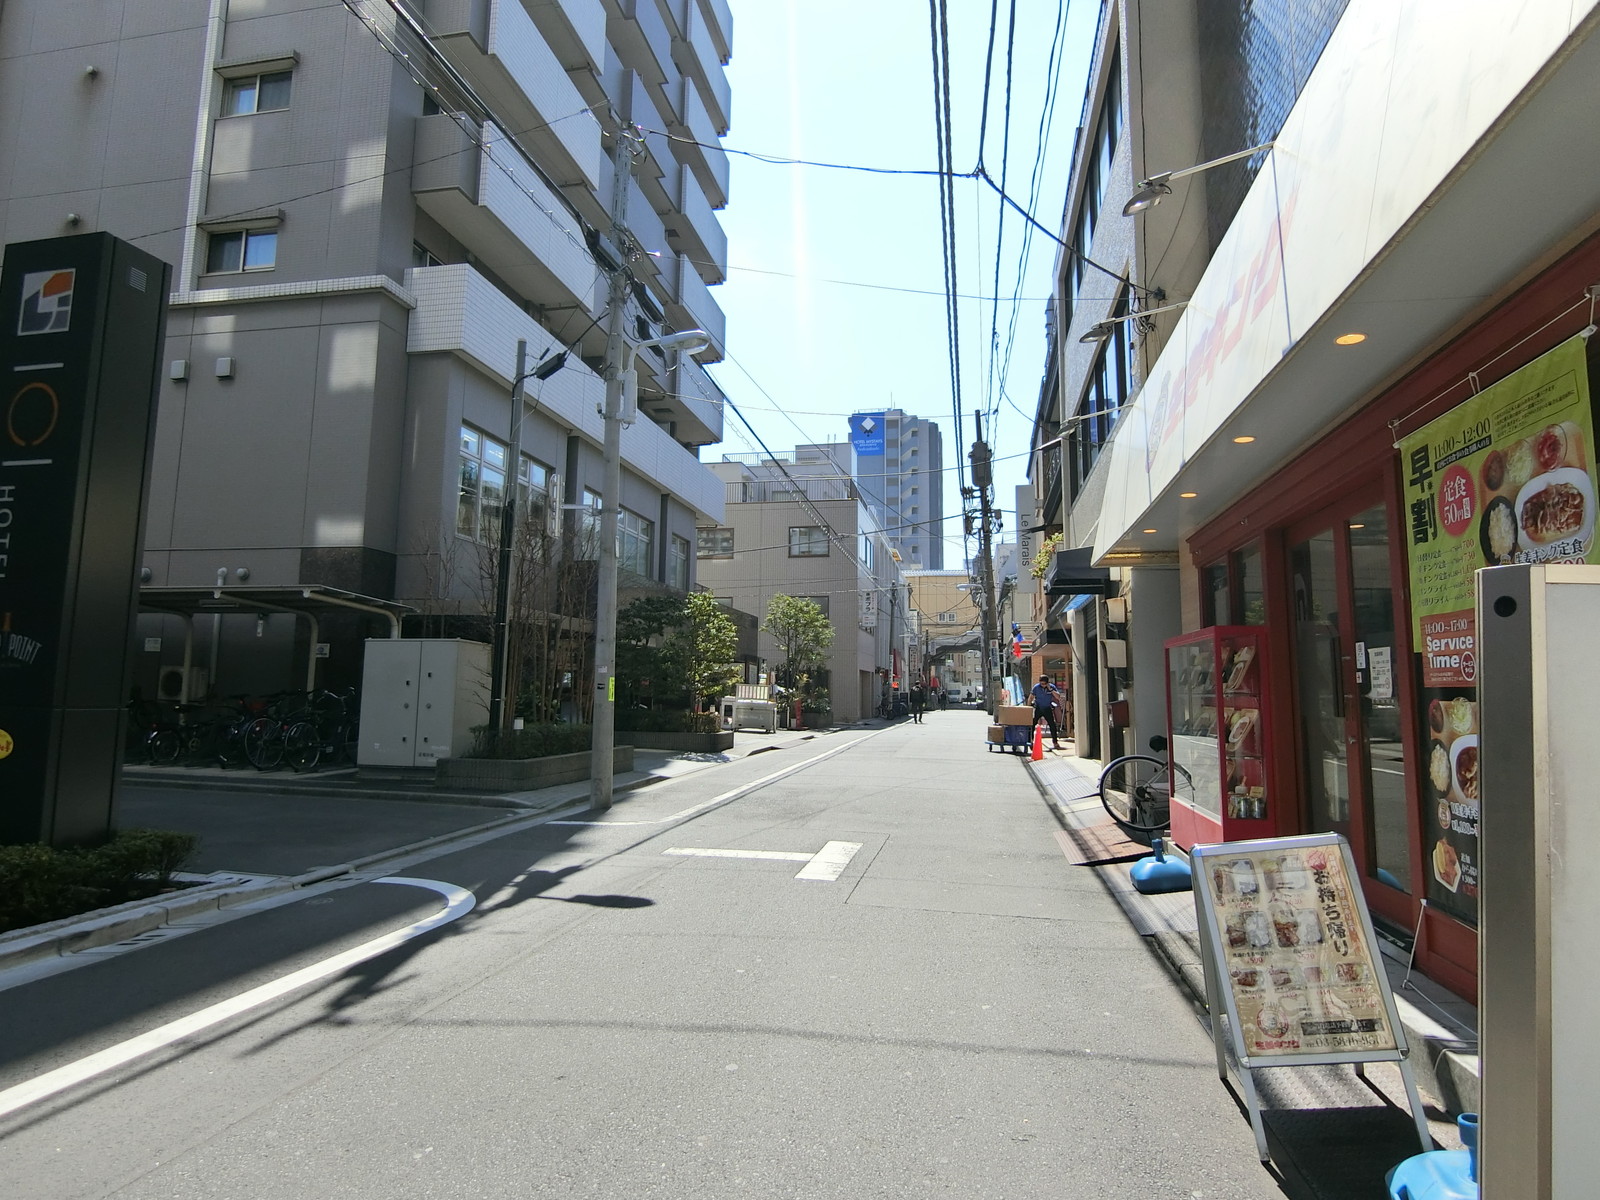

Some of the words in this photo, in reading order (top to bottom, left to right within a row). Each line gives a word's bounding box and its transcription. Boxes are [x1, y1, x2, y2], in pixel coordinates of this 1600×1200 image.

[1409, 444, 1438, 546] 早割
[1444, 475, 1467, 503] 定食
[1020, 514, 1031, 527] Le
[1021, 529, 1032, 566] Marais
[1514, 538, 1584, 564] 生姜キング定食
[8, 633, 43, 664] POINT
[1426, 635, 1474, 652] Service
[1428, 653, 1460, 669] Time
[1313, 869, 1349, 957] お持ち帰り
